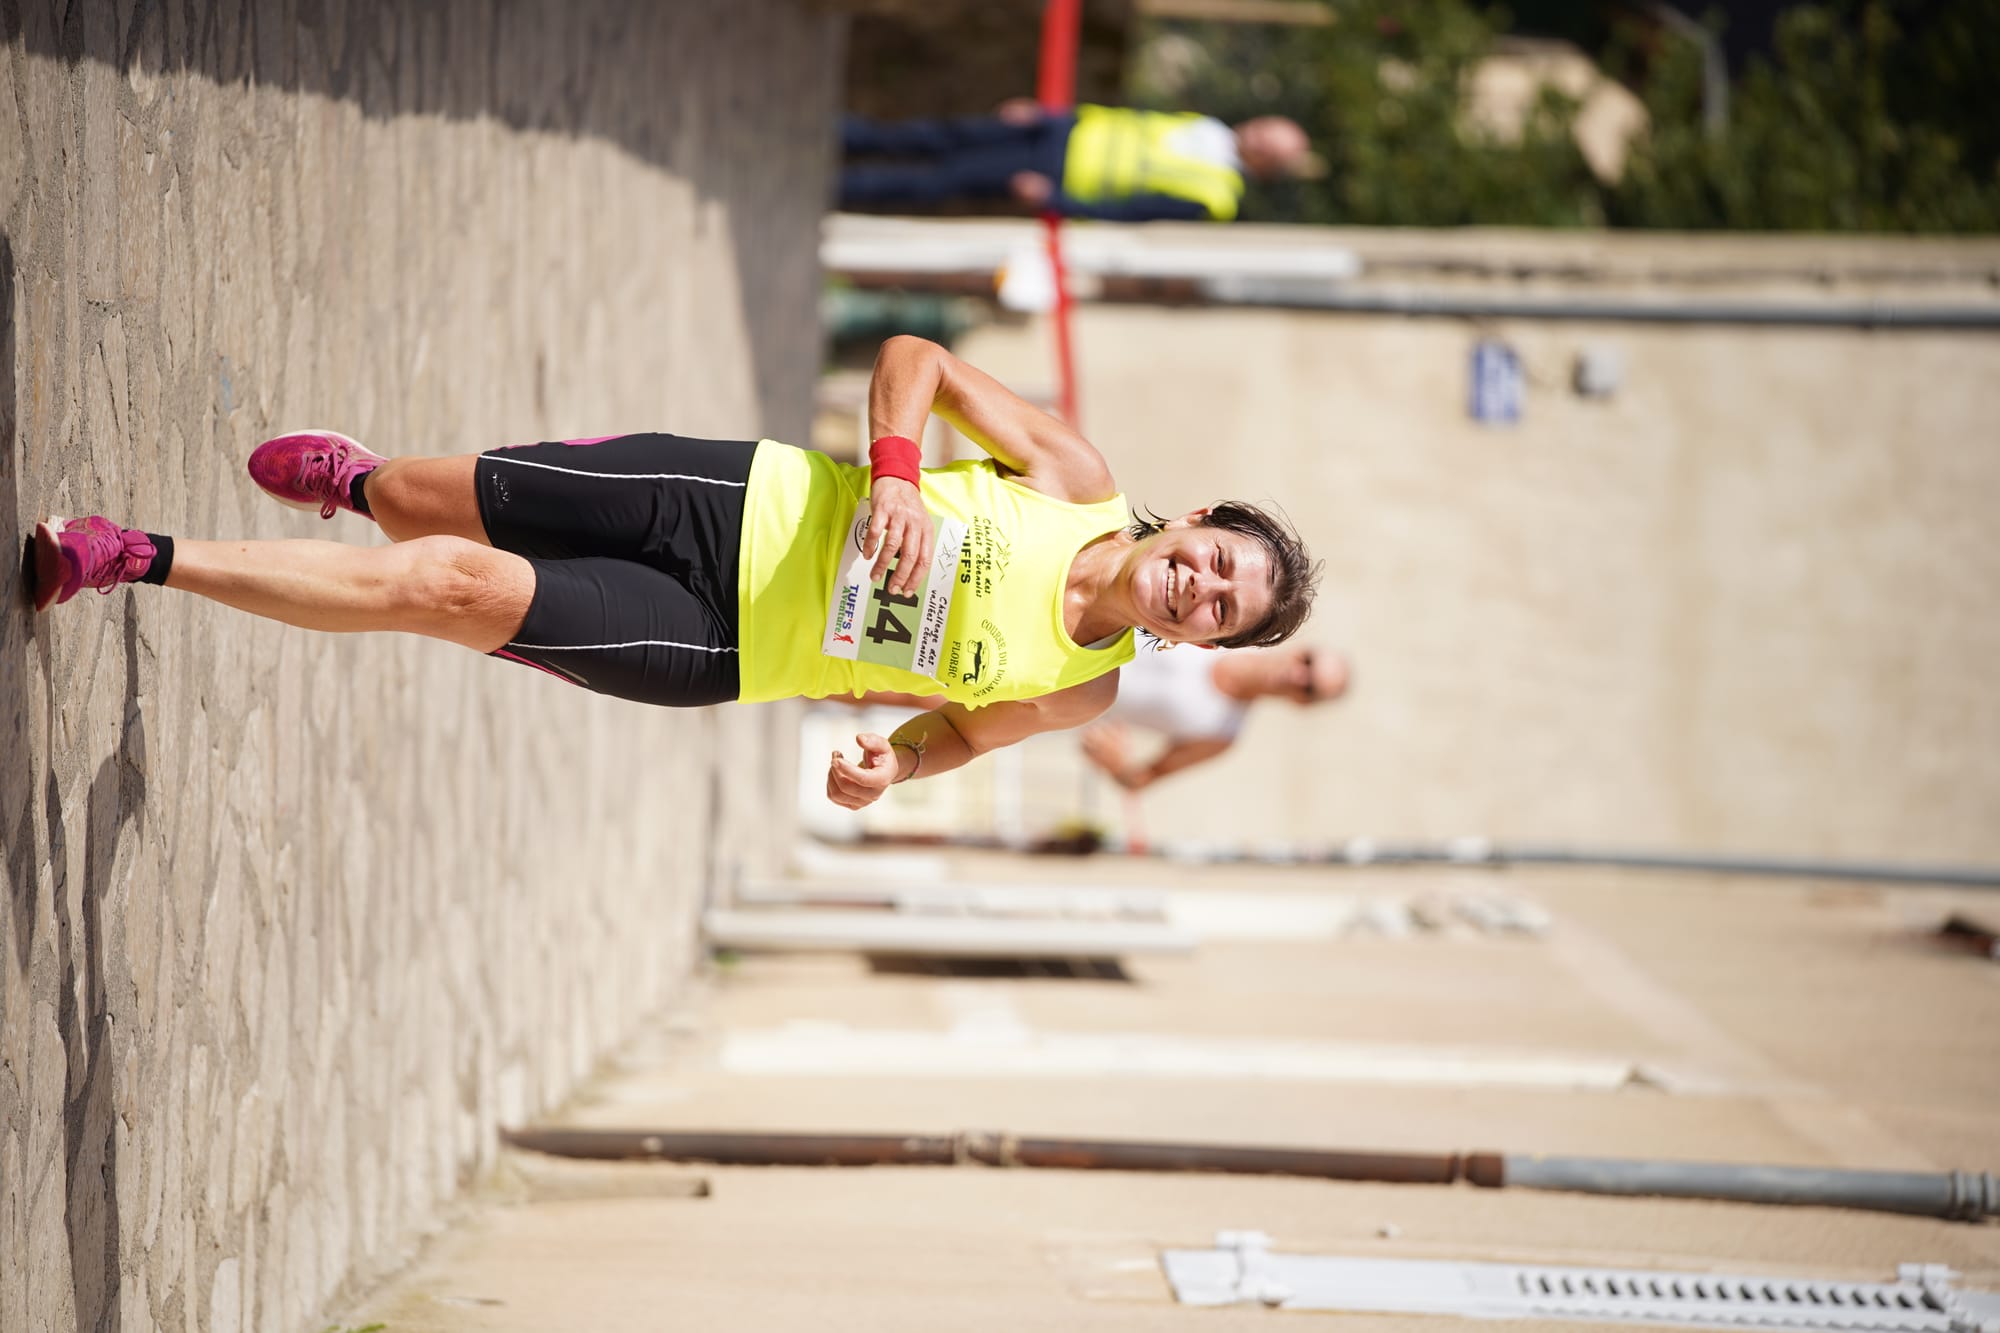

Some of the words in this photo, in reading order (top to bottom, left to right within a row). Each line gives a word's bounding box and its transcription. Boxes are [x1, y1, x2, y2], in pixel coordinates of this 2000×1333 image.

[960, 527, 971, 584] UFF'S
[983, 518, 993, 571] Challenge
[866, 547, 919, 644] 44
[976, 554, 984, 598] cévenoles
[984, 578, 992, 594] des
[835, 586, 851, 633] Aventure
[842, 584, 860, 630] TUFF'S
[926, 590, 937, 622] vallées
[931, 596, 947, 643] Challenge
[918, 627, 931, 667] cévenoles
[981, 619, 1006, 650] COURSE
[928, 648, 937, 665] des
[948, 640, 961, 678] FLORAC
[998, 651, 1007, 666] DU
[973, 669, 1005, 698] DOLMEN
